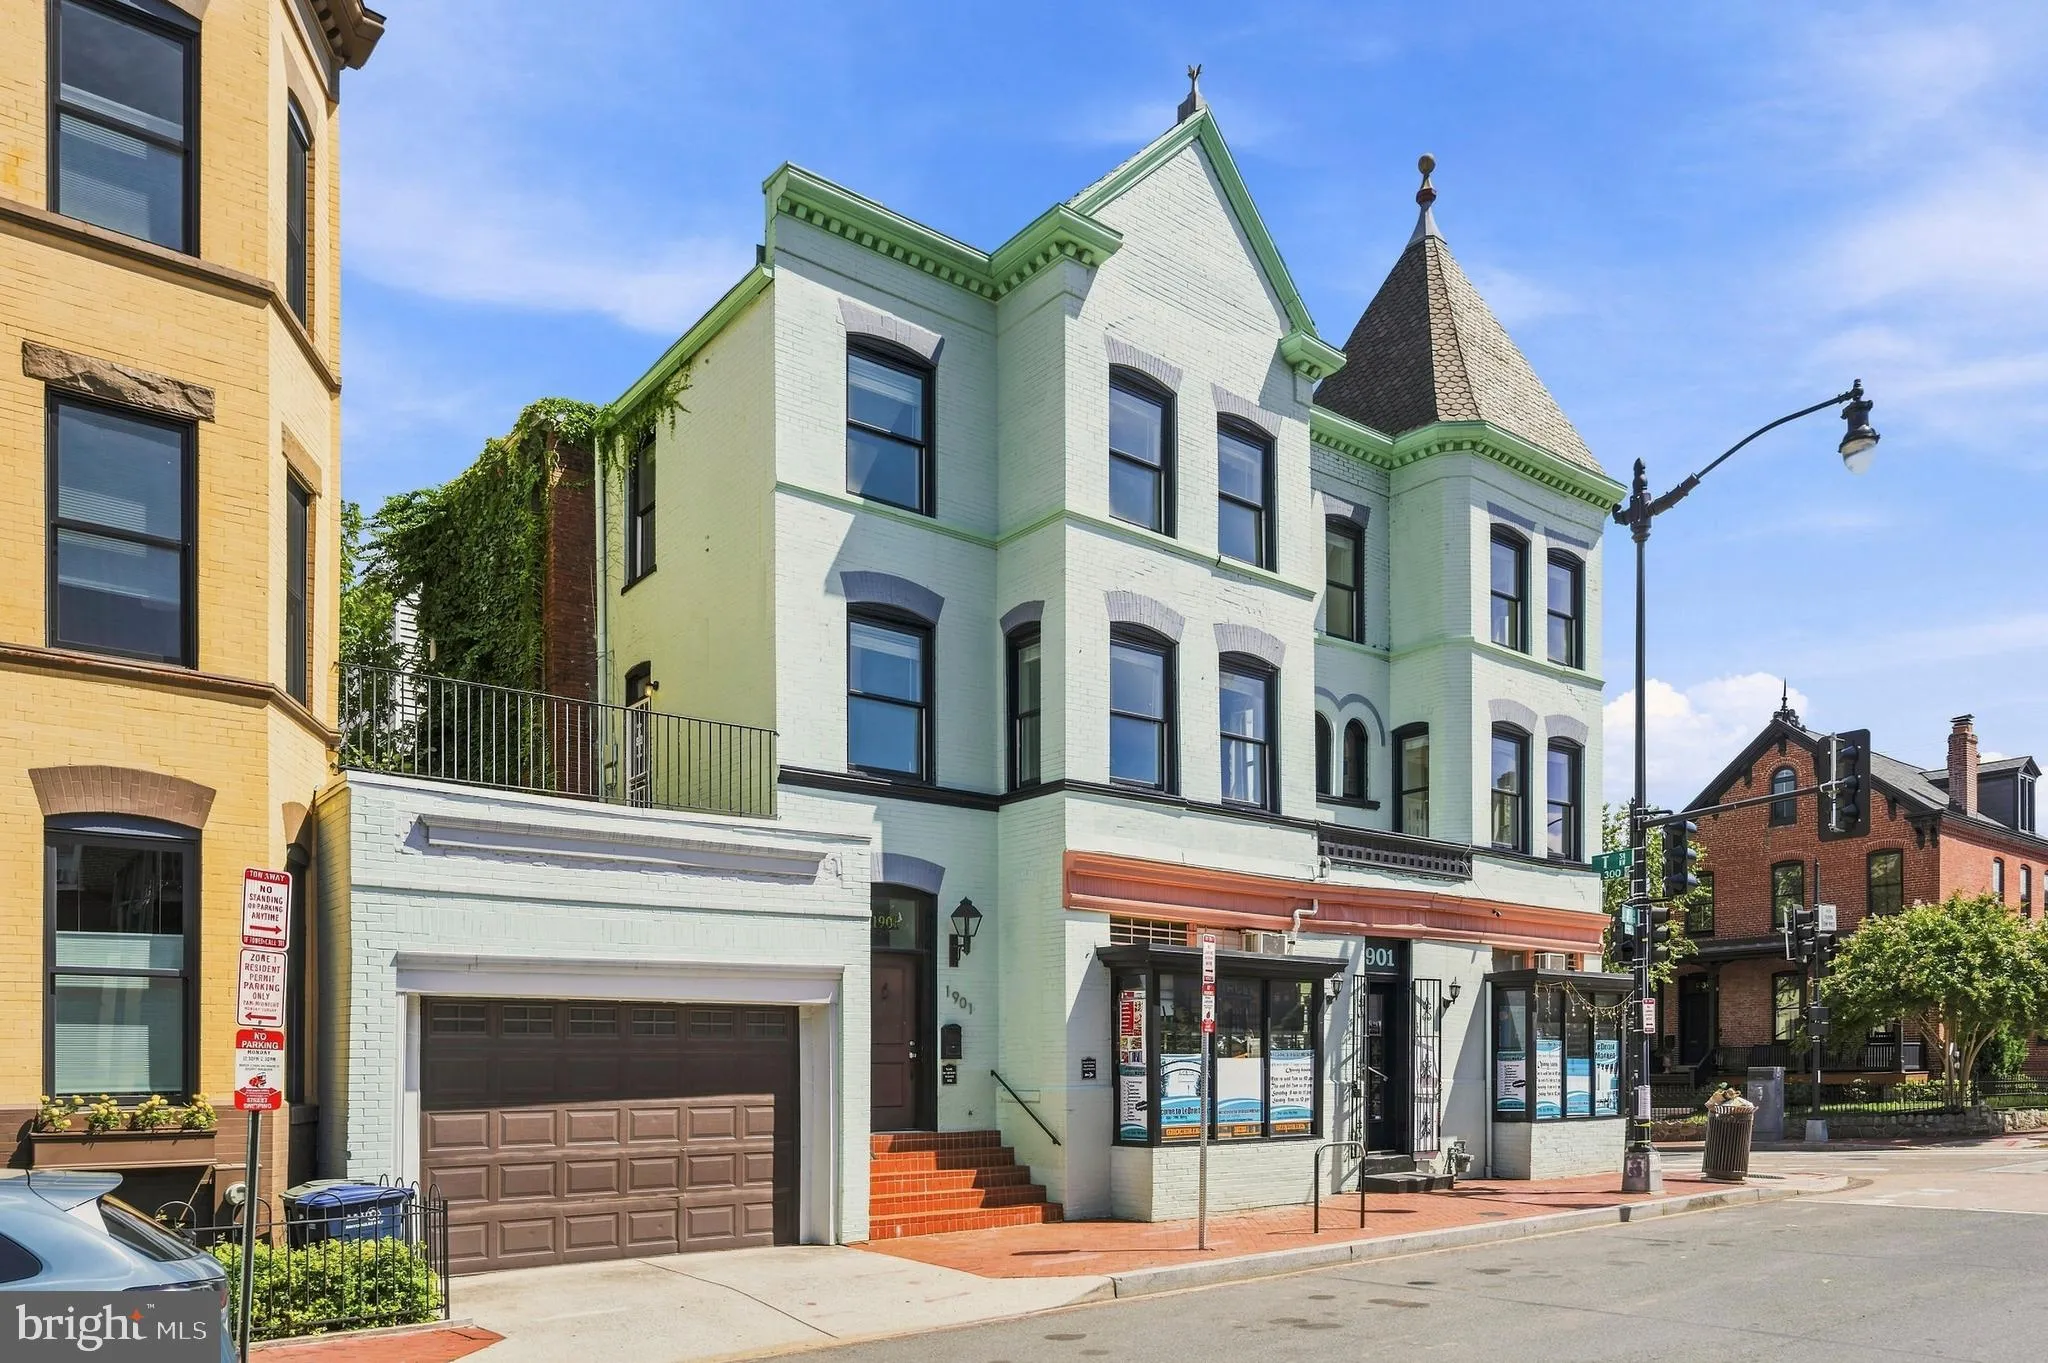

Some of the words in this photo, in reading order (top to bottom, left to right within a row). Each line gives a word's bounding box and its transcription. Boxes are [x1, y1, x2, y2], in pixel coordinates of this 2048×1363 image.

[1602, 856, 1609, 869] T
[264, 873, 285, 882] AWAY
[1604, 869, 1621, 879] 300
[260, 885, 273, 894] NO
[249, 893, 284, 905] STANDING
[256, 904, 284, 913] PARKING
[252, 912, 280, 922] ANYTIME
[250, 954, 271, 963] ZONE
[244, 962, 281, 974] RESIDENT
[250, 974, 275, 983] PERMIT
[244, 982, 280, 992] PARKING
[252, 992, 270, 1000] ONLY
[946, 985, 974, 1015] 1901
[254, 1032, 267, 1040] NO
[242, 1040, 279, 1050] PARKING
